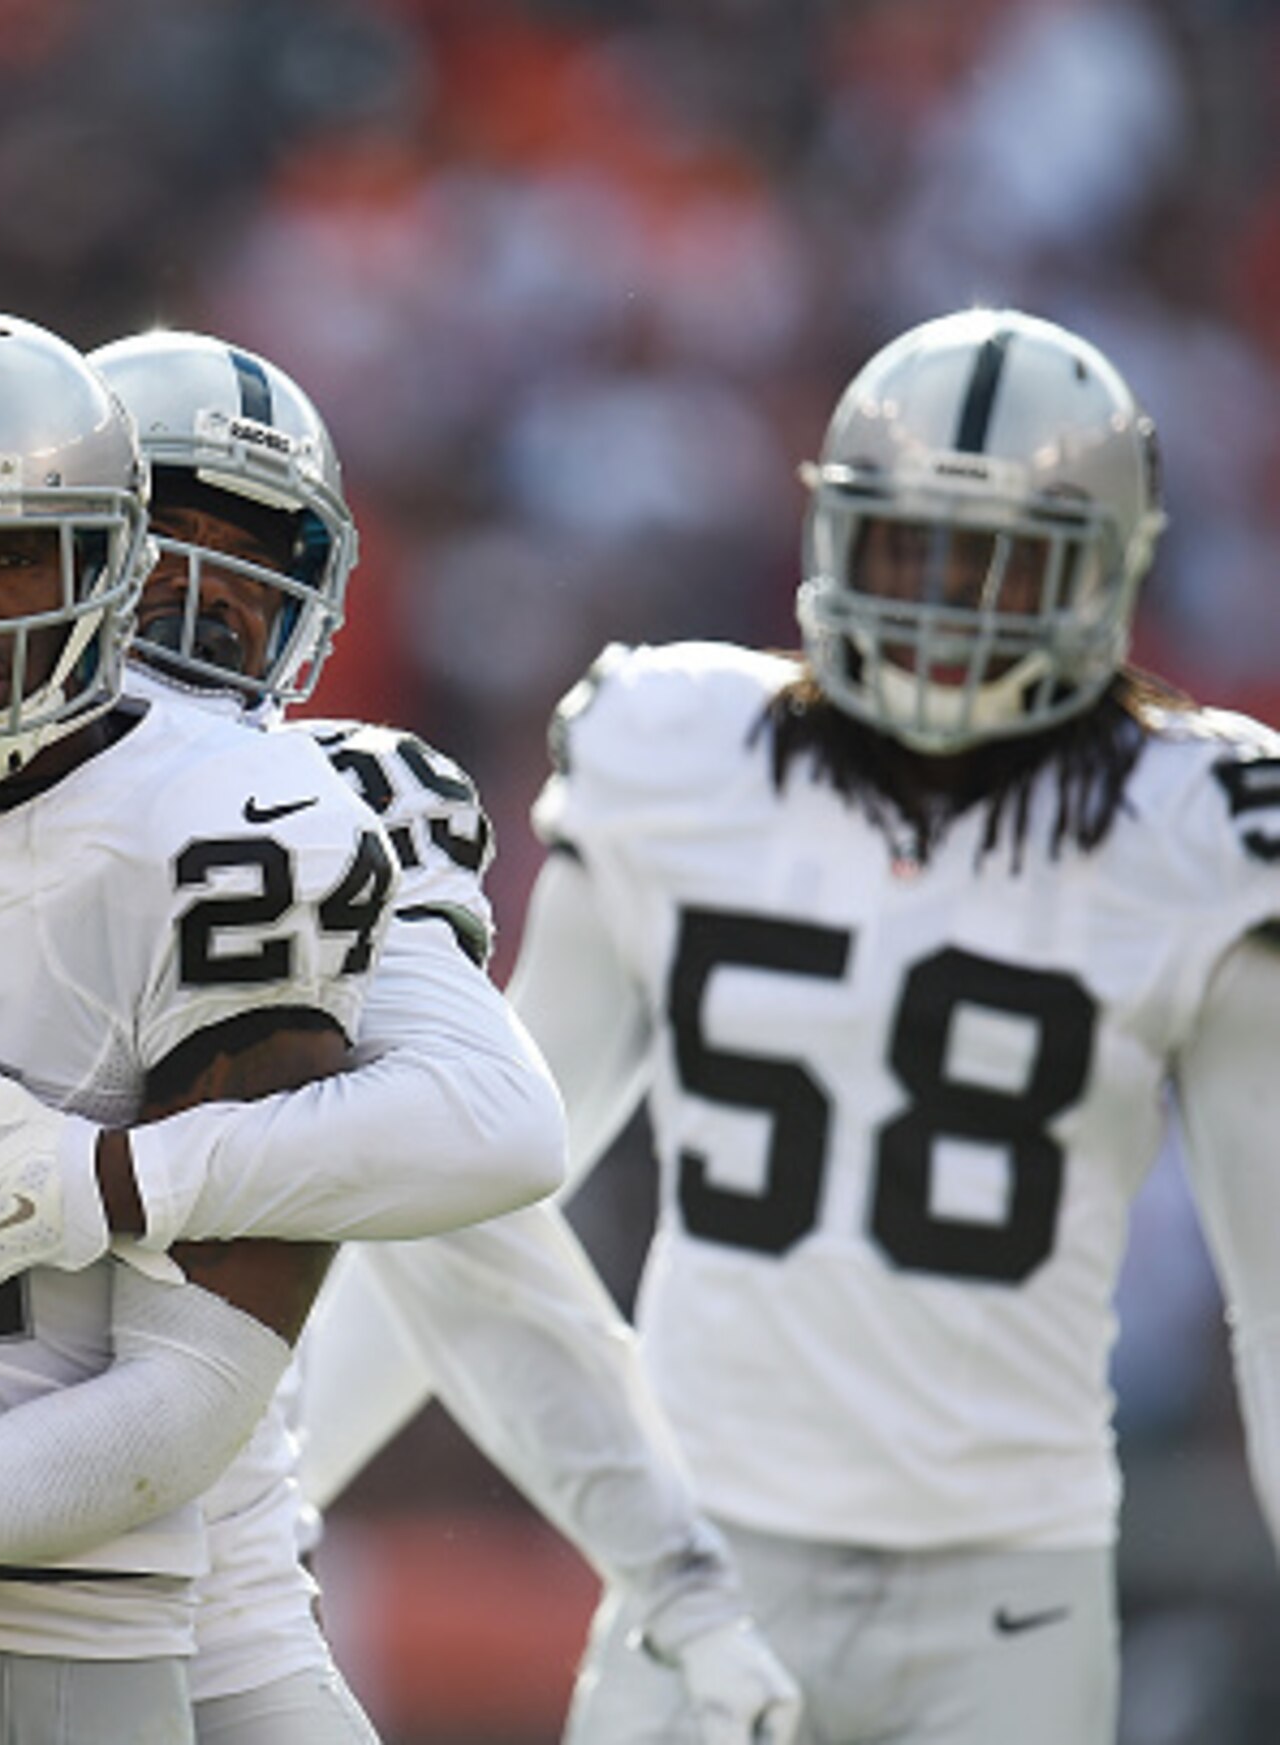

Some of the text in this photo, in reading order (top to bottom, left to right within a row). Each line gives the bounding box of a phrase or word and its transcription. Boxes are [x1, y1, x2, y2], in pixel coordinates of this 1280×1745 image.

[231, 421, 289, 453] RAIDERS
[175, 831, 394, 984] 24
[668, 904, 1100, 1288] 58
